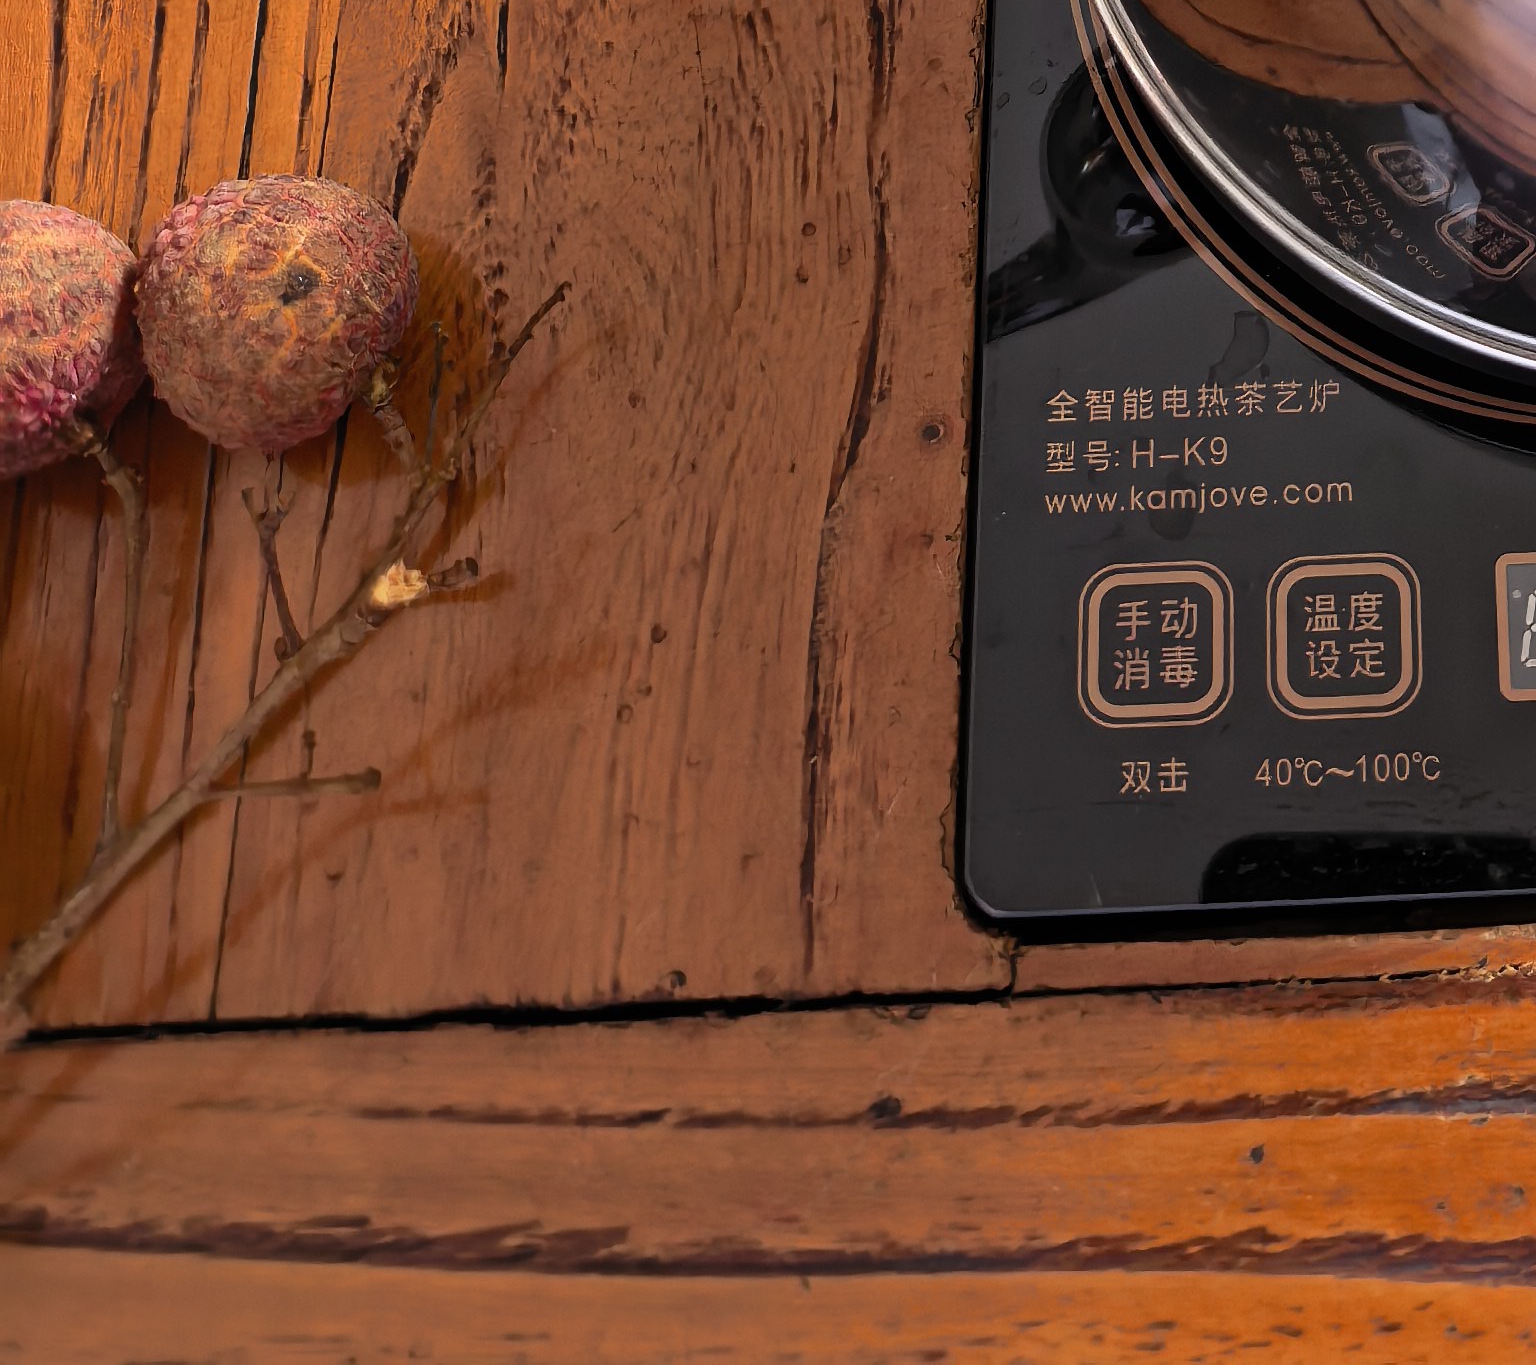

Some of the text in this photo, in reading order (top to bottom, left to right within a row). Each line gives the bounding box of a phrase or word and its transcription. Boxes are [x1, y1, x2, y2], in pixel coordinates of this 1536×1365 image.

[1046, 378, 1341, 423] 全智能电热茶艺炉
[1044, 479, 1354, 515] www.kamjove.com
[1115, 596, 1199, 641] 手动
[1304, 590, 1385, 634] 温度
[1113, 644, 1200, 691] 消毒
[1305, 638, 1387, 680] 设定
[1120, 757, 1190, 795] 双击
